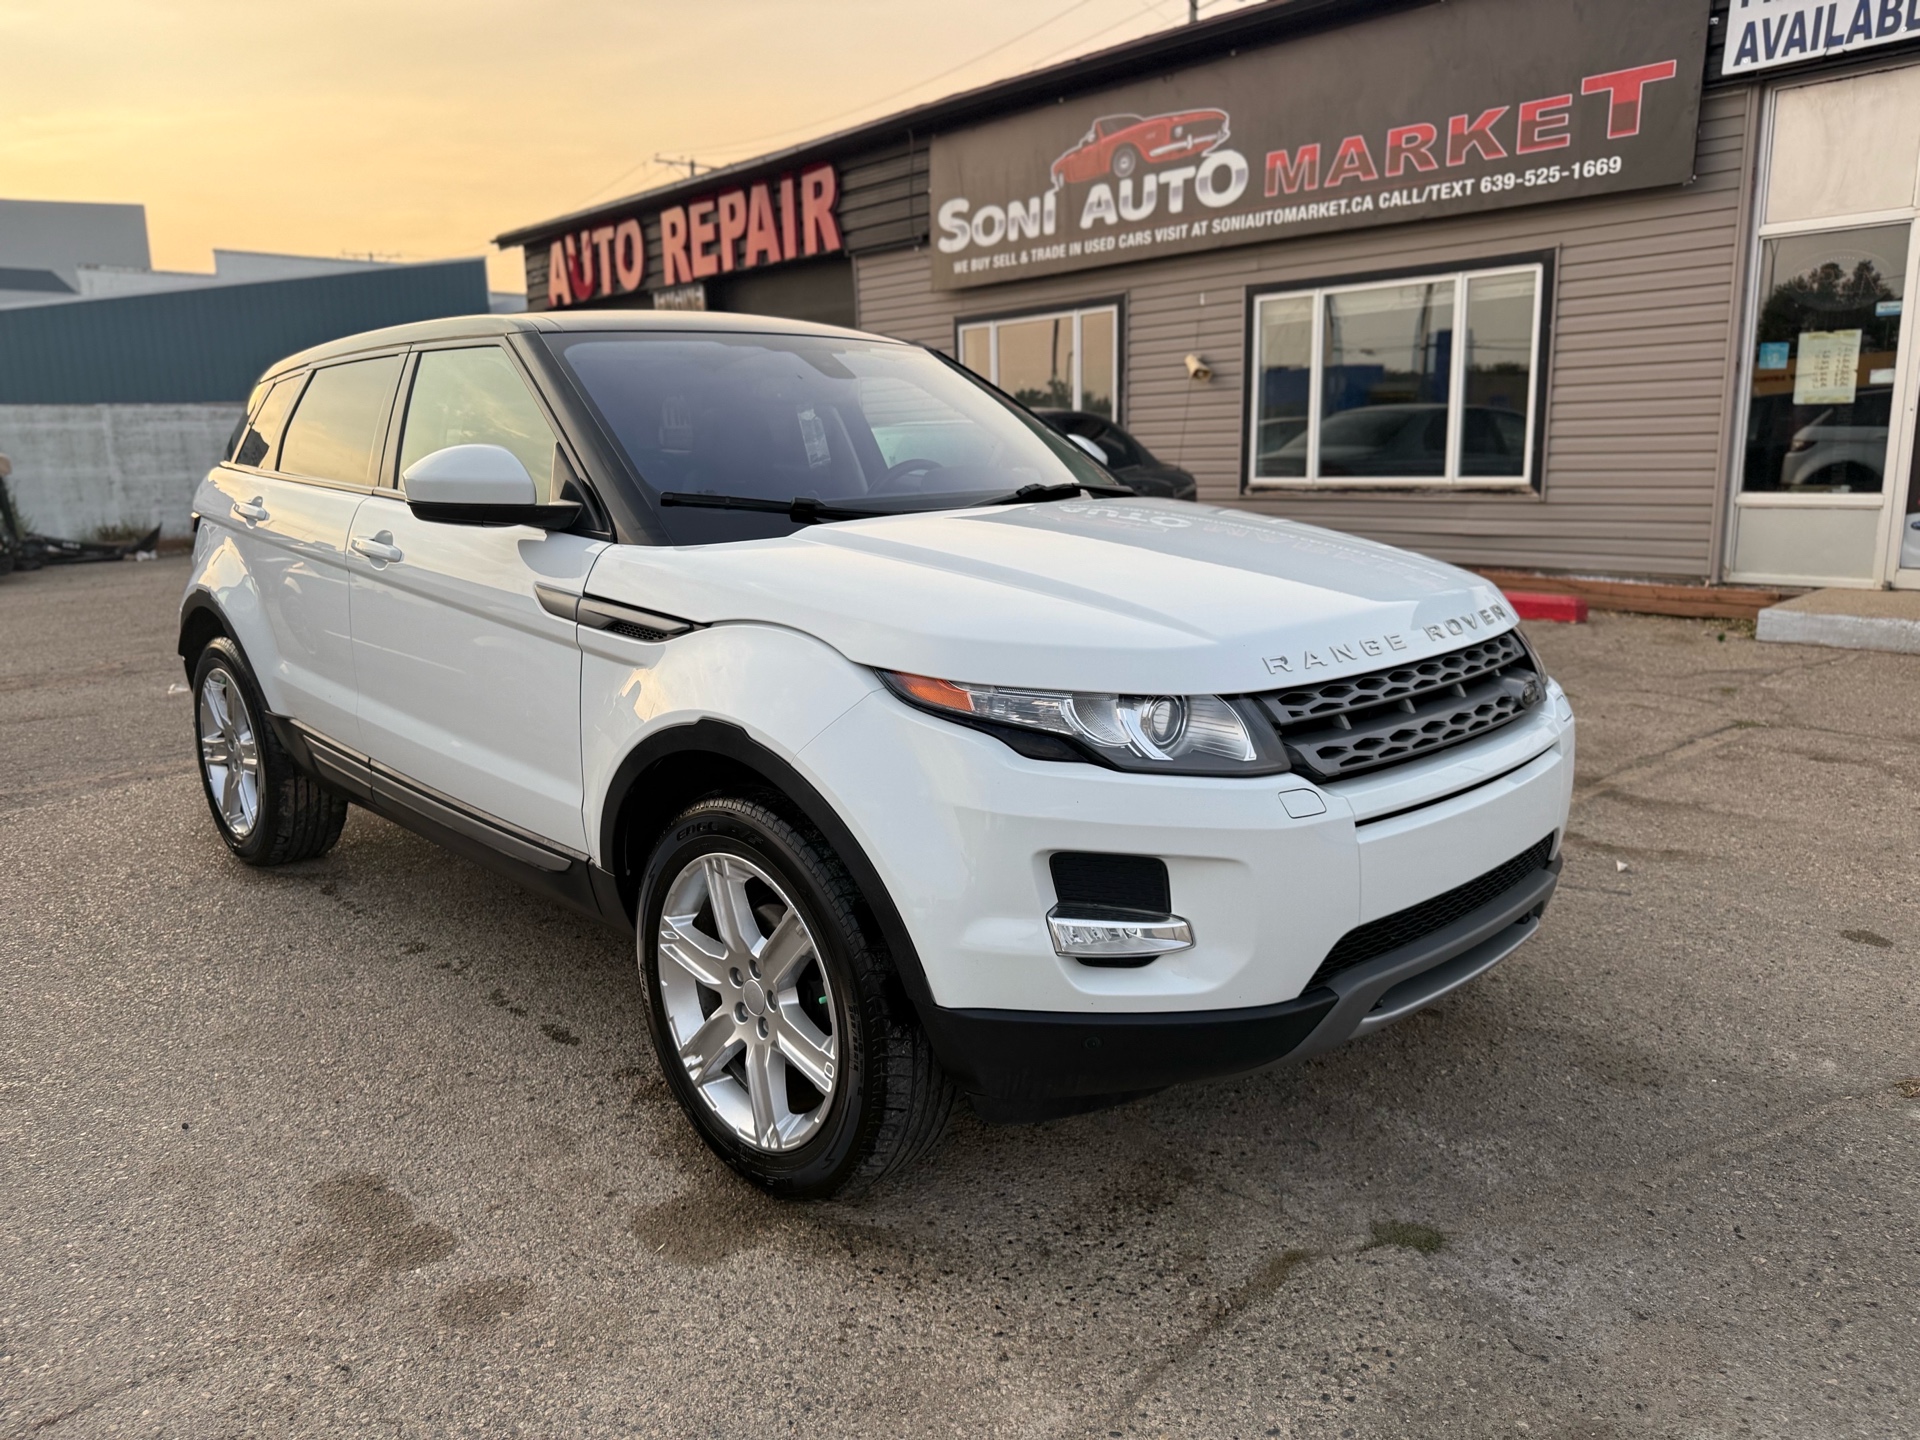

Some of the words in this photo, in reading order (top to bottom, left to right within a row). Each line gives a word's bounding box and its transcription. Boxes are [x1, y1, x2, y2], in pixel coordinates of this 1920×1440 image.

[938, 190, 1056, 253] SONI
[1080, 150, 1248, 229] AUTO
[1264, 59, 1677, 197] MARKET
[953, 257, 968, 274] WE
[971, 256, 991, 272] BUY
[992, 253, 1017, 268] SELL
[1019, 250, 1028, 265] &
[1031, 243, 1066, 263] TRADE
[1069, 242, 1081, 257] IN
[1084, 237, 1115, 254] USED
[1119, 230, 1152, 249] CARS
[1155, 223, 1188, 243] VISIT
[1191, 219, 1209, 237] AT
[1211, 194, 1373, 234] SONIAUTOMARKET.CA
[1378, 178, 1475, 209] CALL/TEXT
[1480, 156, 1622, 194] 639-525-1669
[548, 217, 644, 308] AUTO
[660, 162, 841, 287] REPAIR
[1262, 634, 1407, 675] RANGE
[1423, 603, 1507, 642] ROVER
